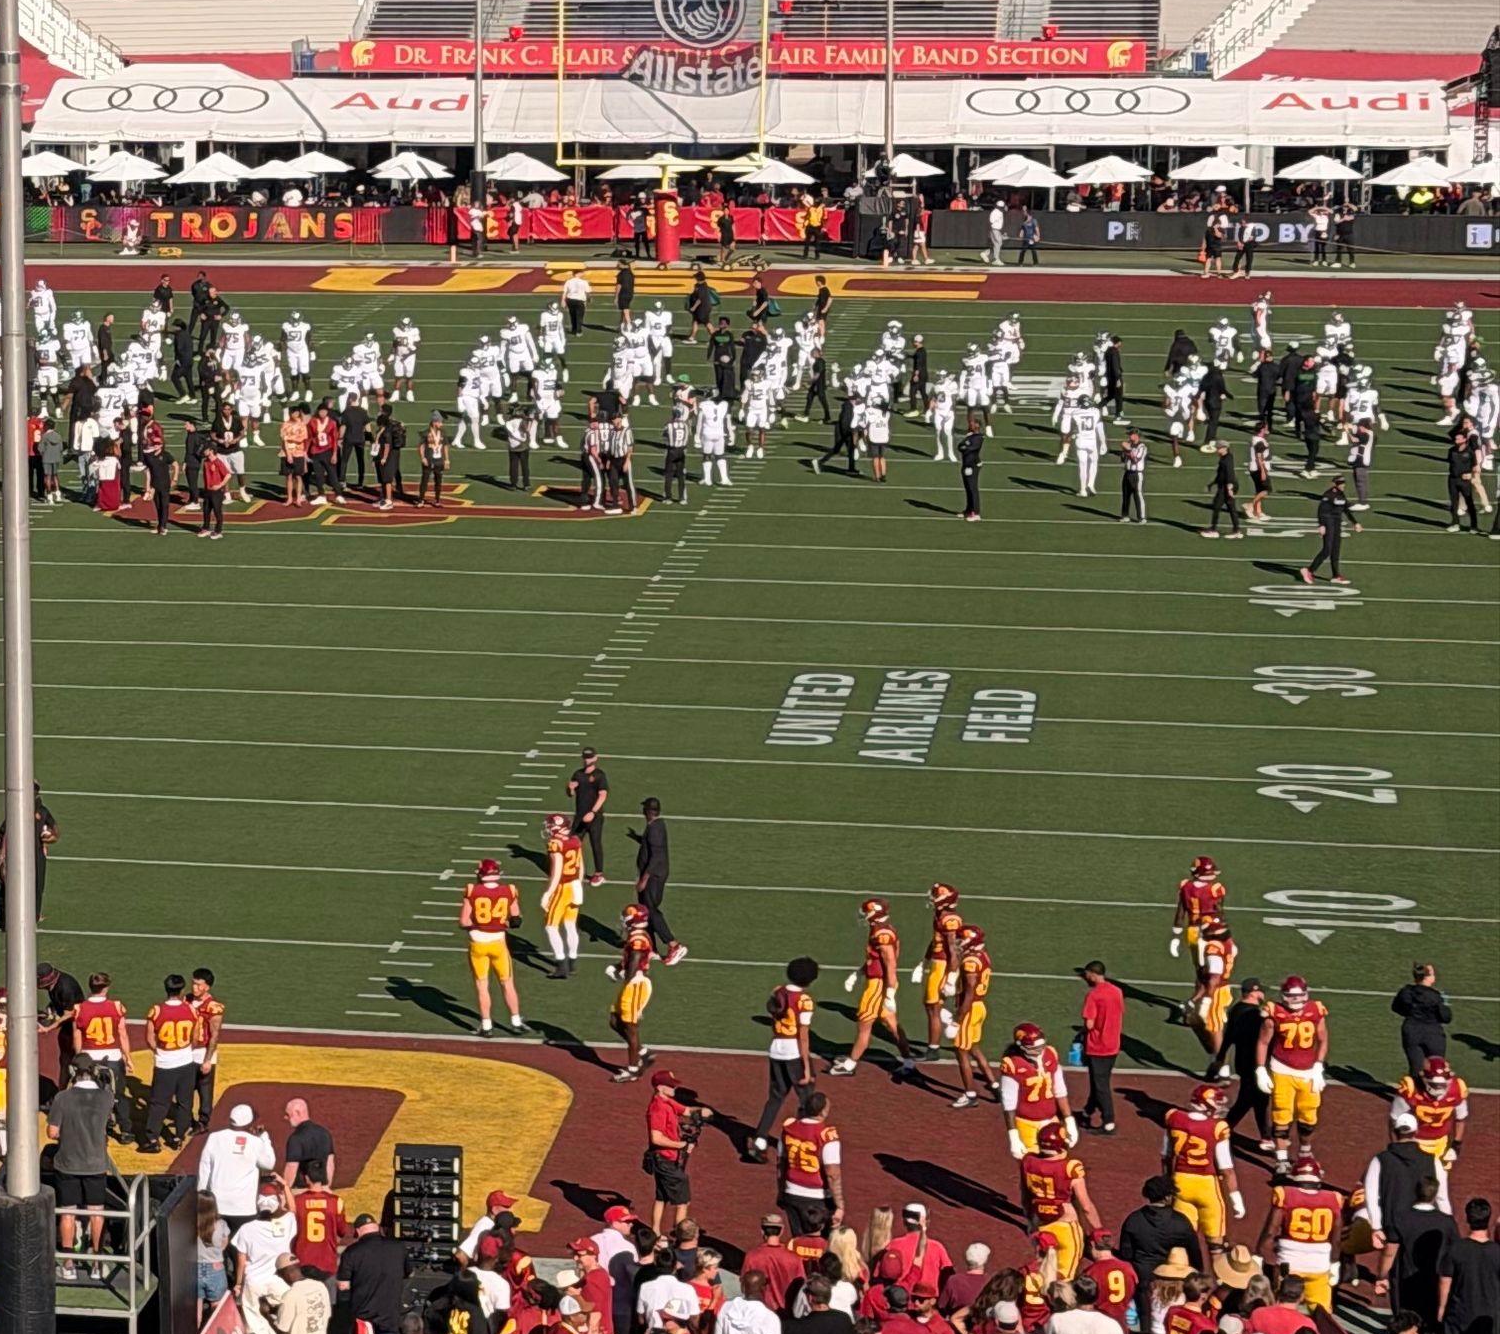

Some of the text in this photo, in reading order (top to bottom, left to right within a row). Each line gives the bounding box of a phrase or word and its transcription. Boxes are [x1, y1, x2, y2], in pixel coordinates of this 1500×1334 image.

[441, 46, 513, 66] FRANK
[521, 46, 544, 66] C.
[911, 45, 980, 66] BAND
[985, 45, 1088, 66] SECTION
[622, 49, 762, 96] Allstate
[330, 92, 488, 112] Audi
[1262, 91, 1432, 111] Audi
[149, 210, 355, 239] TROJANS
[1278, 223, 1312, 244] BY
[311, 266, 989, 298] USC
[1251, 665, 1378, 699] 30
[764, 669, 1039, 764] UNITED AIRLINES FIELD
[1255, 763, 1398, 806] 20
[473, 897, 509, 925] 84
[1262, 888, 1422, 934] 10
[84, 1016, 114, 1046] 41
[158, 1019, 193, 1049] 40
[1279, 1020, 1316, 1049] 78
[1025, 1076, 1053, 1102] 71
[1171, 1129, 1209, 1167] 72
[305, 1210, 326, 1243] 6
[1287, 1206, 1332, 1242] 60
[1107, 1270, 1126, 1304] 9
